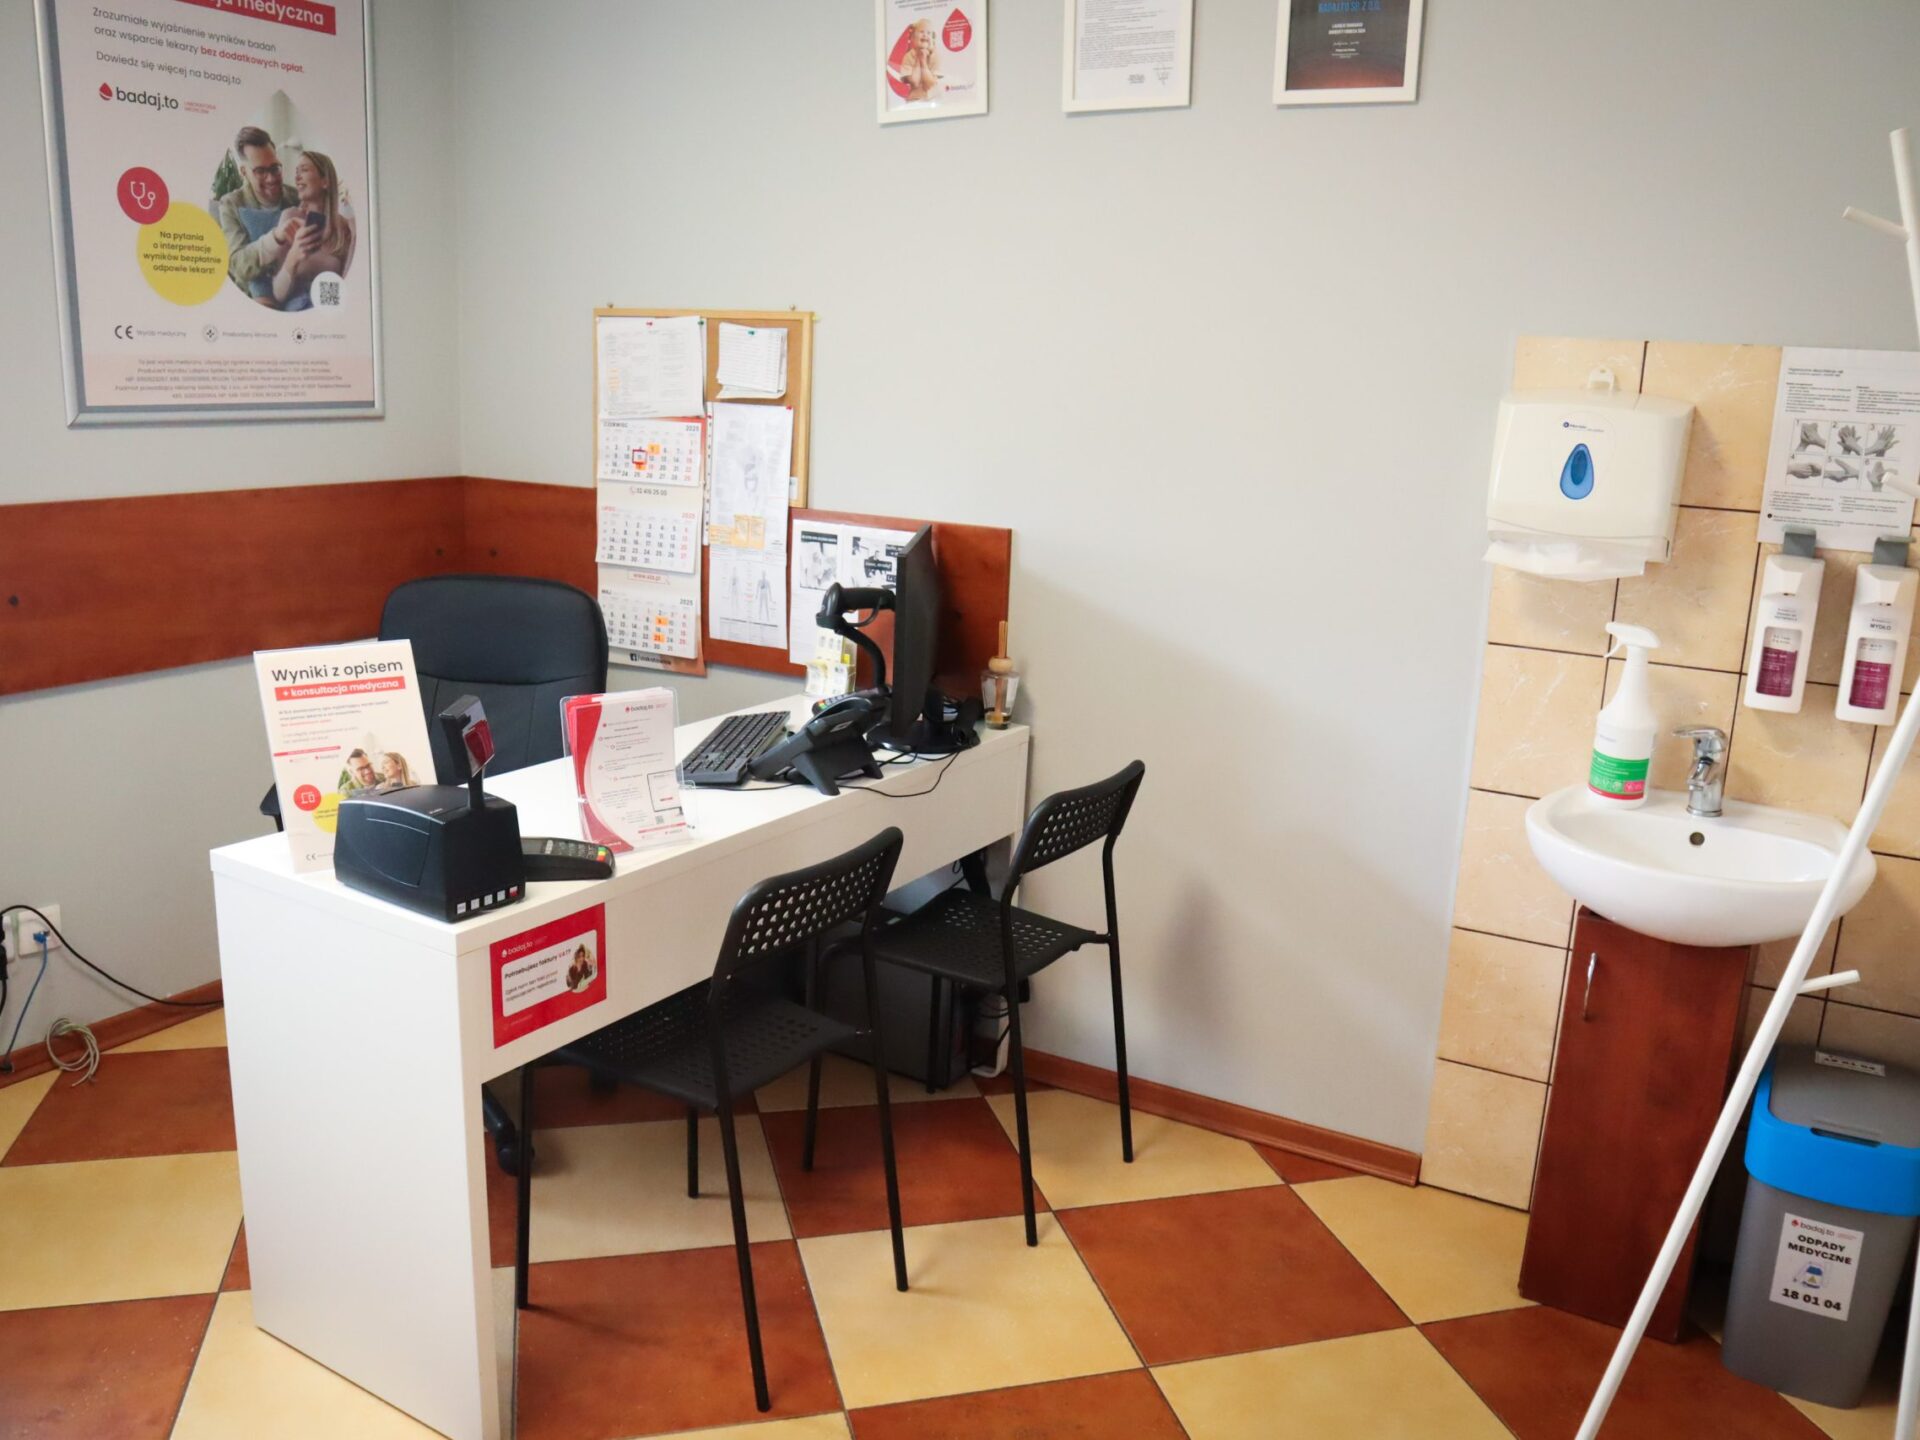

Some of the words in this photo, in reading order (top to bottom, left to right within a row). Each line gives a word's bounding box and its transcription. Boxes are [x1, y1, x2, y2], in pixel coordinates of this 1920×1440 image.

[92, 7, 149, 27] Zrozumiałe
[150, 19, 206, 39] wyjaśnienie
[207, 31, 247, 47] wyników
[248, 38, 276, 52] badań
[94, 26, 117, 38] oraz
[118, 30, 165, 48] wsparcie
[166, 38, 200, 56] lekarzy
[200, 45, 218, 57] bez
[219, 49, 280, 70] dodatkowych
[280, 61, 306, 75] opłat.
[96, 51, 139, 67] Dowiedz
[141, 58, 155, 71] się
[157, 62, 188, 78] więcej
[188, 69, 202, 79] na
[203, 70, 242, 86] badaj.to
[116, 86, 180, 112] badaj.to
[160, 231, 171, 239] Na
[172, 231, 204, 243] pytania
[160, 242, 212, 254] interpretację
[143, 252, 179, 263] wyników
[180, 254, 222, 266] bezpłatnie
[153, 265, 187, 275] odpowie
[271, 664, 329, 684] Wyniki
[332, 666, 340, 677] z
[343, 660, 404, 679] opisem
[290, 683, 348, 698] konsultacja
[348, 679, 400, 693] medyczna
[507, 940, 534, 956] badaj.to
[505, 962, 539, 979] Potrzebujesz
[1797, 1234, 1846, 1253] ODPADY
[1787, 1242, 1853, 1265] MEDYCZNE
[1781, 1288, 1800, 1300] 18
[1803, 1293, 1820, 1306] 01
[1824, 1299, 1842, 1311] 04
